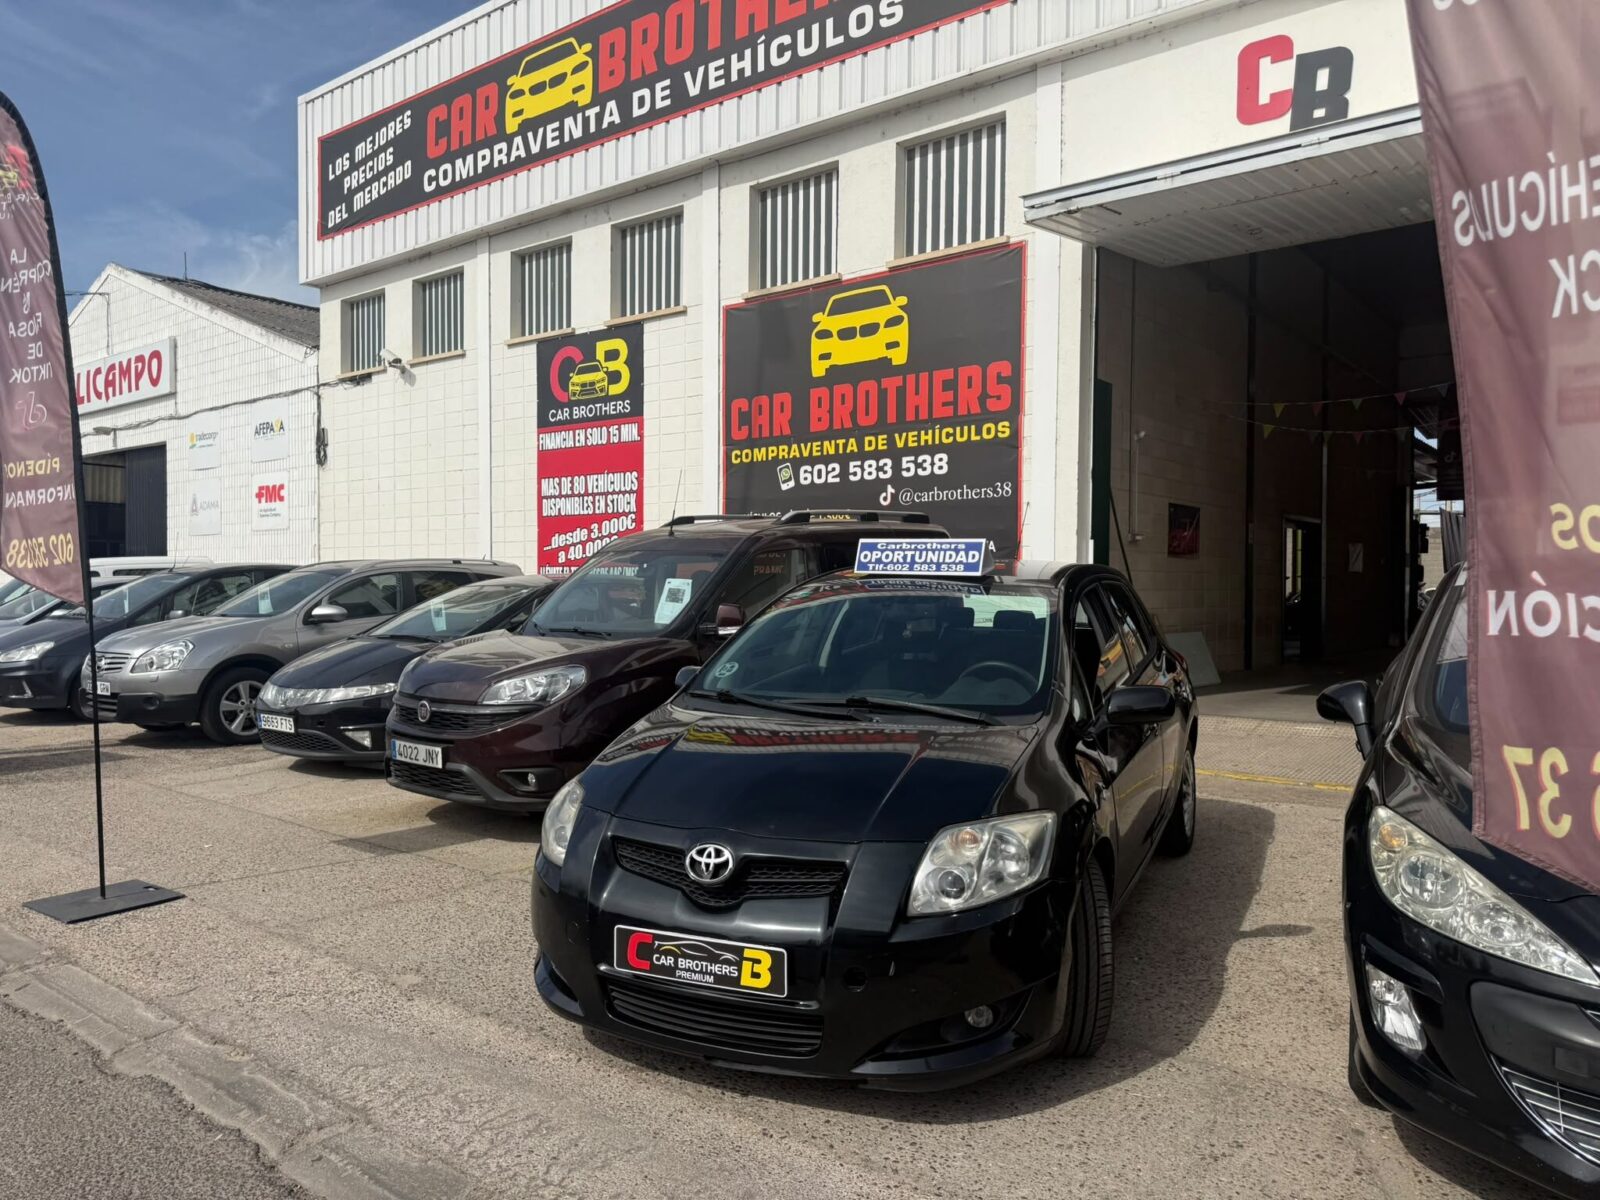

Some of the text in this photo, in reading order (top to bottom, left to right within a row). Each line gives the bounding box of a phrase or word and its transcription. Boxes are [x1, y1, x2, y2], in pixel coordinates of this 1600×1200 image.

[426, 0, 829, 160] CAR BROTH
[423, 0, 904, 193] COMPRAVENTA DE VEHÍCULOS
[328, 109, 412, 181] LOS MEJORES
[343, 147, 394, 195] PRECIOS
[328, 160, 412, 229] DEL MERCADO
[548, 400, 631, 422] CAR BROTHERS
[730, 360, 1012, 441] CAR BROTHERS
[539, 430, 574, 451] FINANCIA
[575, 428, 585, 447] EN
[586, 426, 607, 446] SOLO
[608, 425, 619, 444] 15
[731, 420, 1010, 464] COMPRAVENTA DE VEHÍCULOS
[799, 453, 949, 485] 602 583 538
[255, 483, 285, 504] FMC
[541, 470, 638, 497] MAS DE 80 VEHÍCULOS
[898, 481, 1012, 506] @carbrothers38
[542, 493, 637, 517] DISPONIBLES EN STOCK
[590, 513, 636, 539] 3.000€
[558, 551, 565, 564] a
[860, 550, 980, 563] OPORTUNIDAD
[876, 542, 966, 550] Carbrothers
[940, 564, 965, 572] 538
[280, 718, 293, 731] FTS
[398, 743, 439, 765] 4022 JNY
[652, 953, 674, 967] CAR
[678, 957, 738, 977] BROTHERS
[676, 970, 714, 984] PREMIUM
